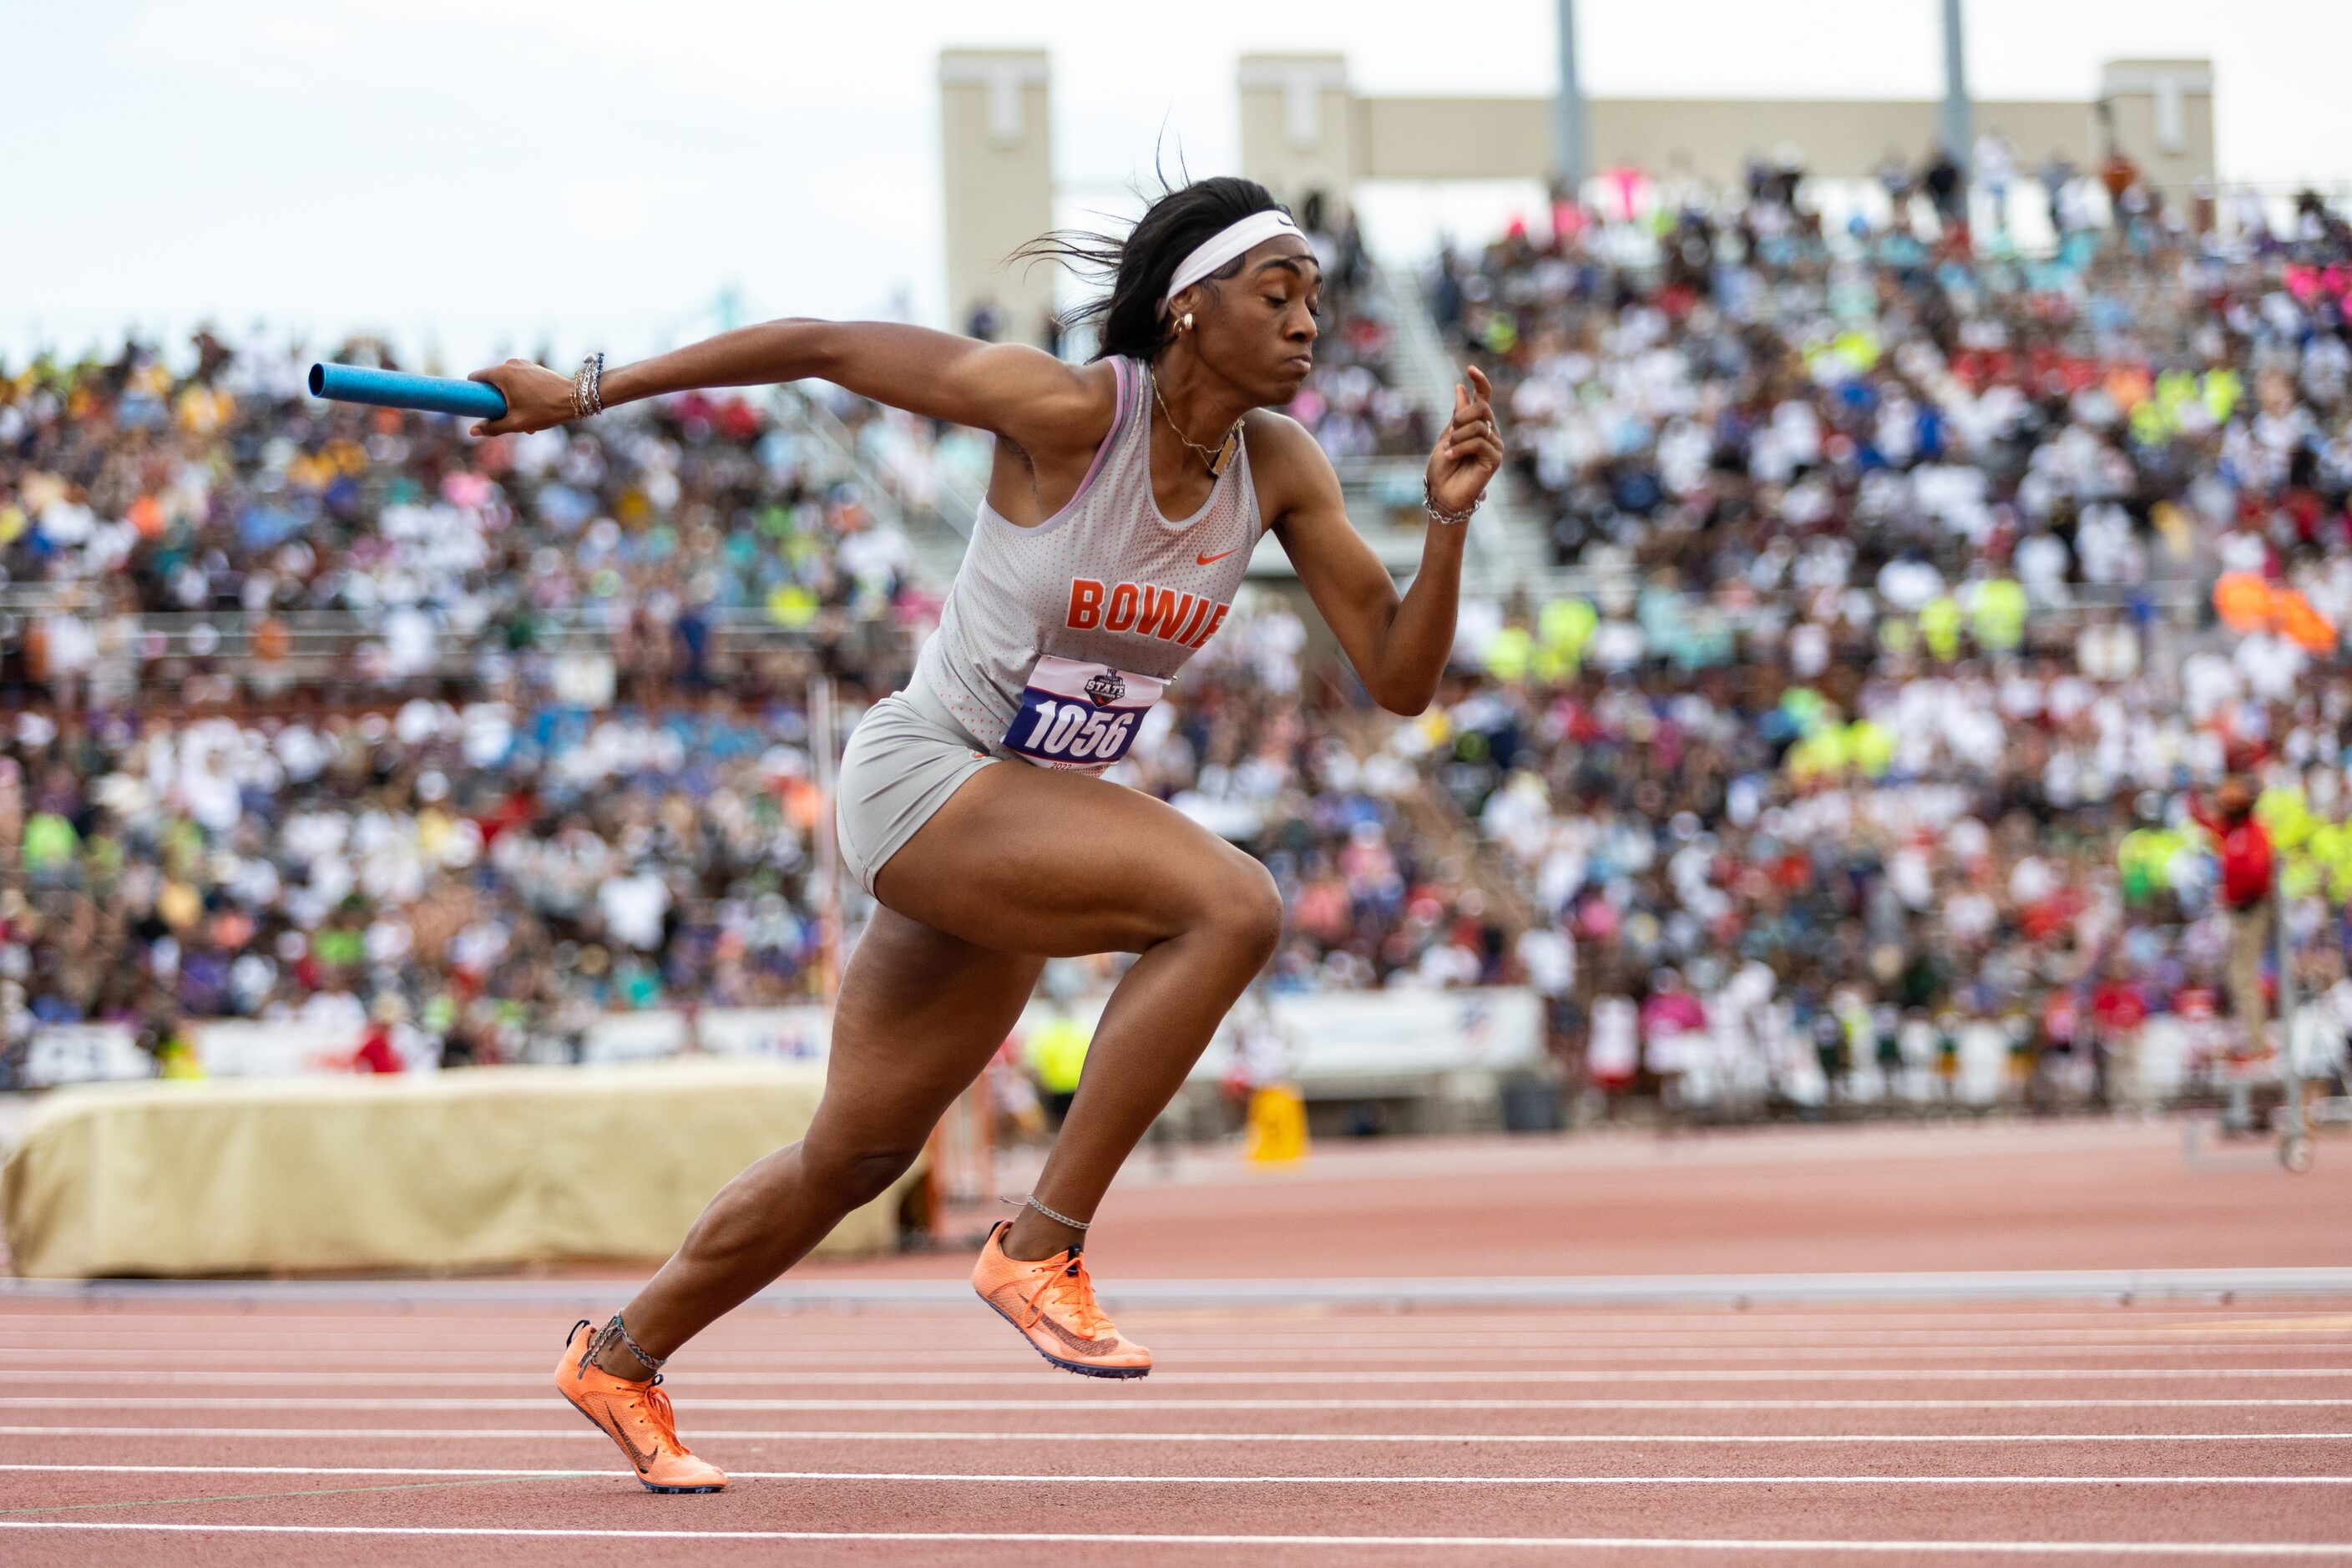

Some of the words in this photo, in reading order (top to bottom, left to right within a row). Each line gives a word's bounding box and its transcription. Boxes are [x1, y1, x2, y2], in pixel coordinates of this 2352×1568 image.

[1085, 680, 1125, 697] STATE
[1024, 701, 1135, 758] 1056
[1050, 761, 1072, 771] 2022
